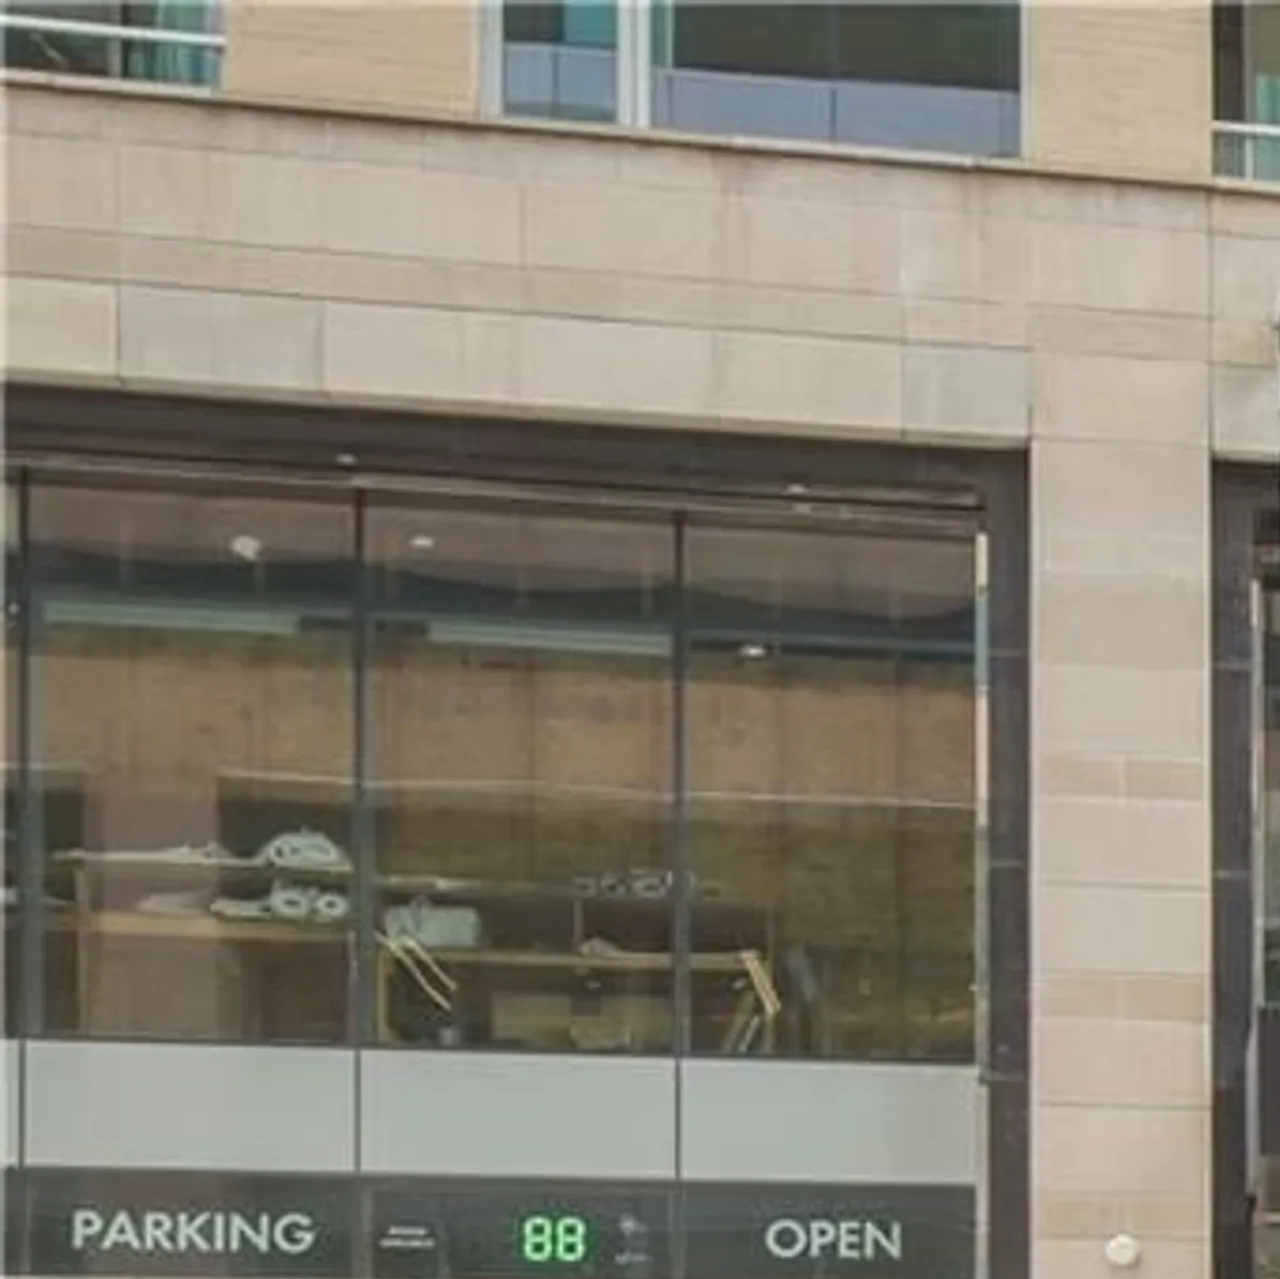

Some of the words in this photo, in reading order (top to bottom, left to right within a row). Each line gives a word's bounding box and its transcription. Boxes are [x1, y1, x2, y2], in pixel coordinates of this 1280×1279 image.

[71, 1208, 316, 1255] PARKING
[523, 1215, 587, 1262] 88
[765, 1217, 903, 1261] OPEN
